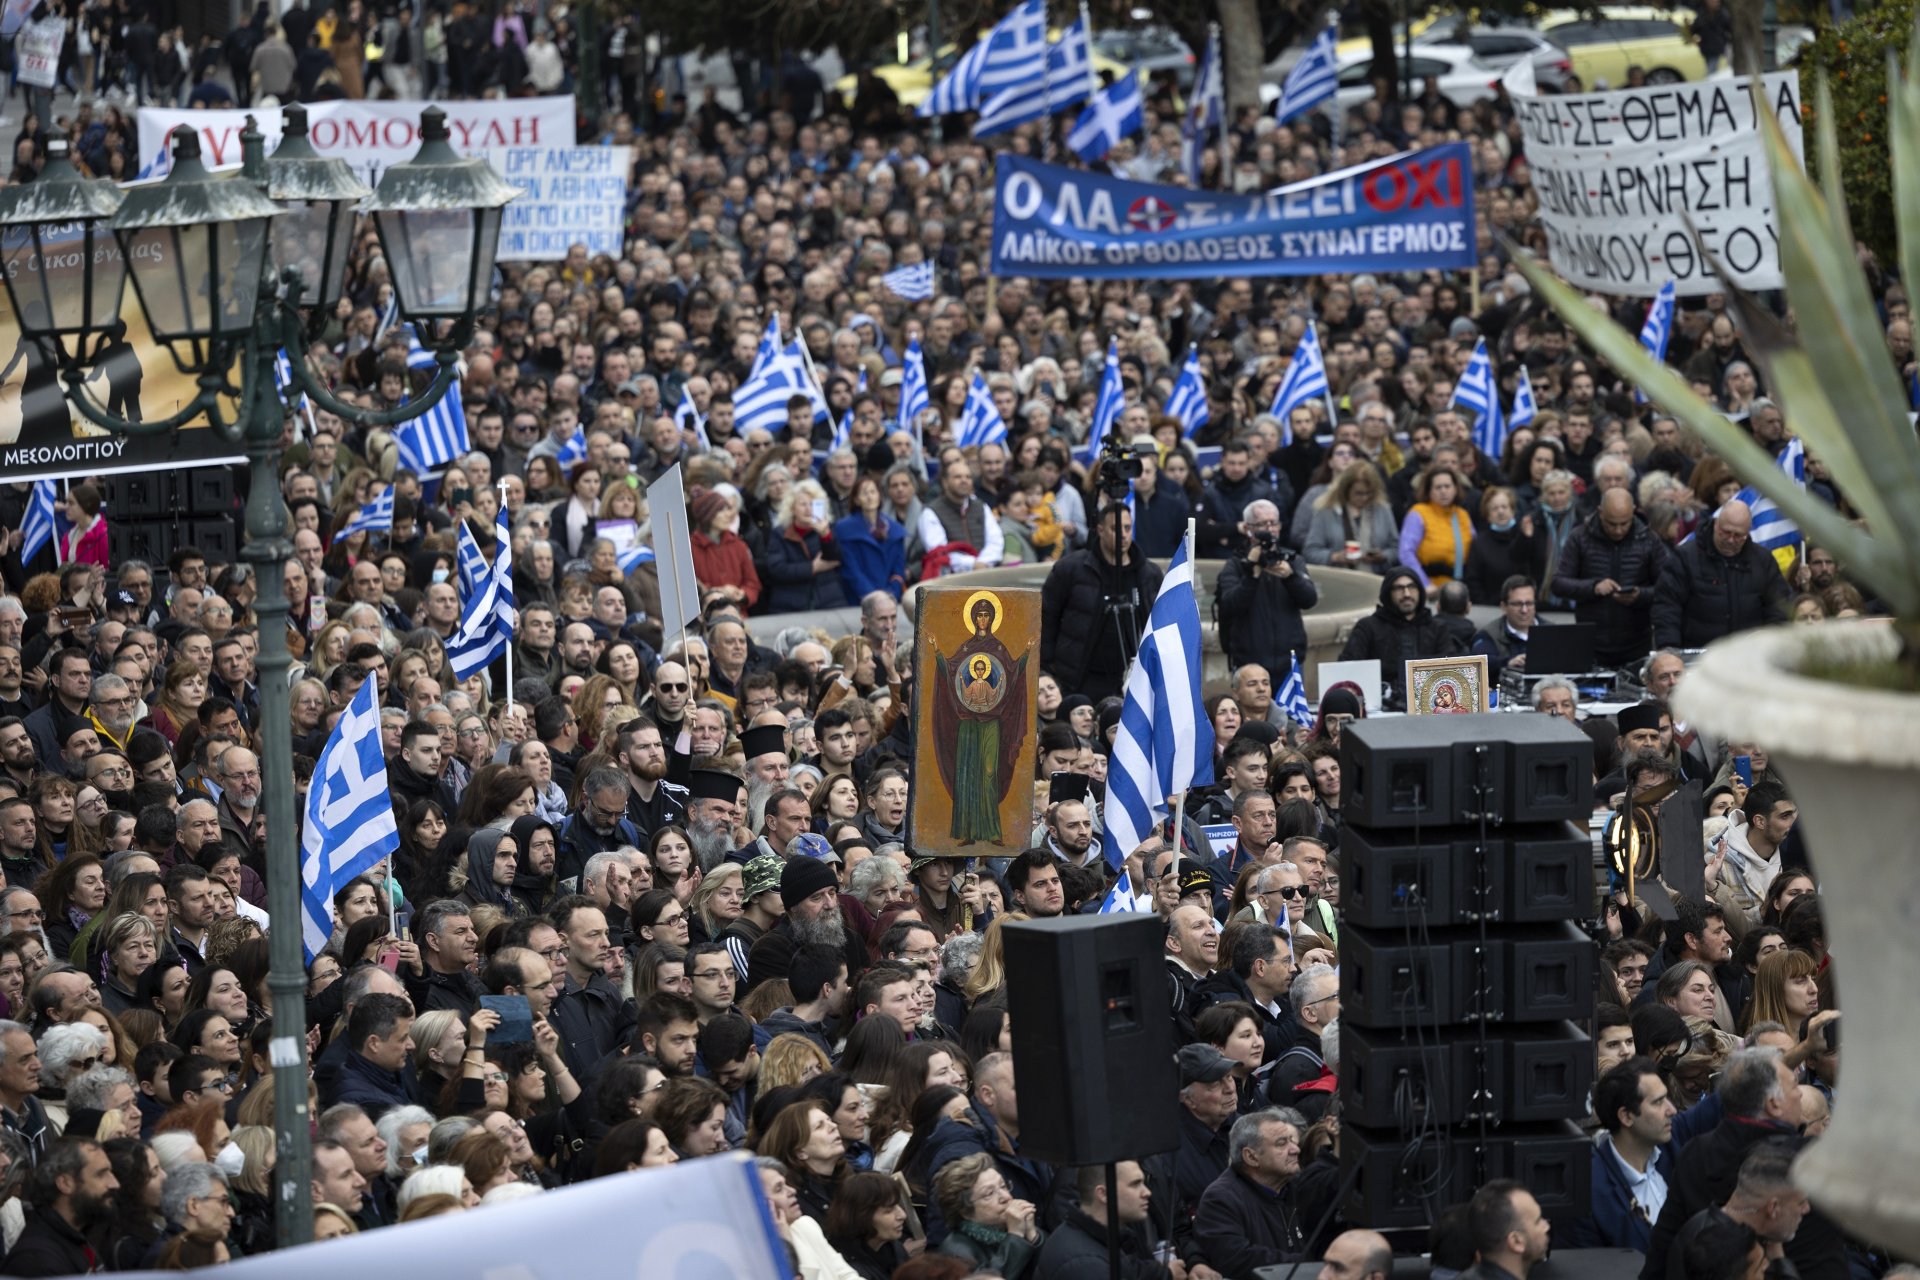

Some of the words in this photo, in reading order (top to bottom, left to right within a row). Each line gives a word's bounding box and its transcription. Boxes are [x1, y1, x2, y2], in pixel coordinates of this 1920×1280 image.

[311, 116, 540, 149] ΟΜΟΥΛΗ
[1003, 171, 1042, 220] Ο
[1362, 158, 1464, 213] ΟΧΙ
[1001, 229, 1099, 264] ΛΑΪΚΟΣ
[1105, 234, 1275, 264] ΟΡΘΟΔΟΞΟΣ
[1281, 222, 1467, 258] ΣΥΝΑΓΕΡΜΟΣ
[4, 440, 125, 467] ΜΕΣΟΛΟΓΓΙΟΥ
